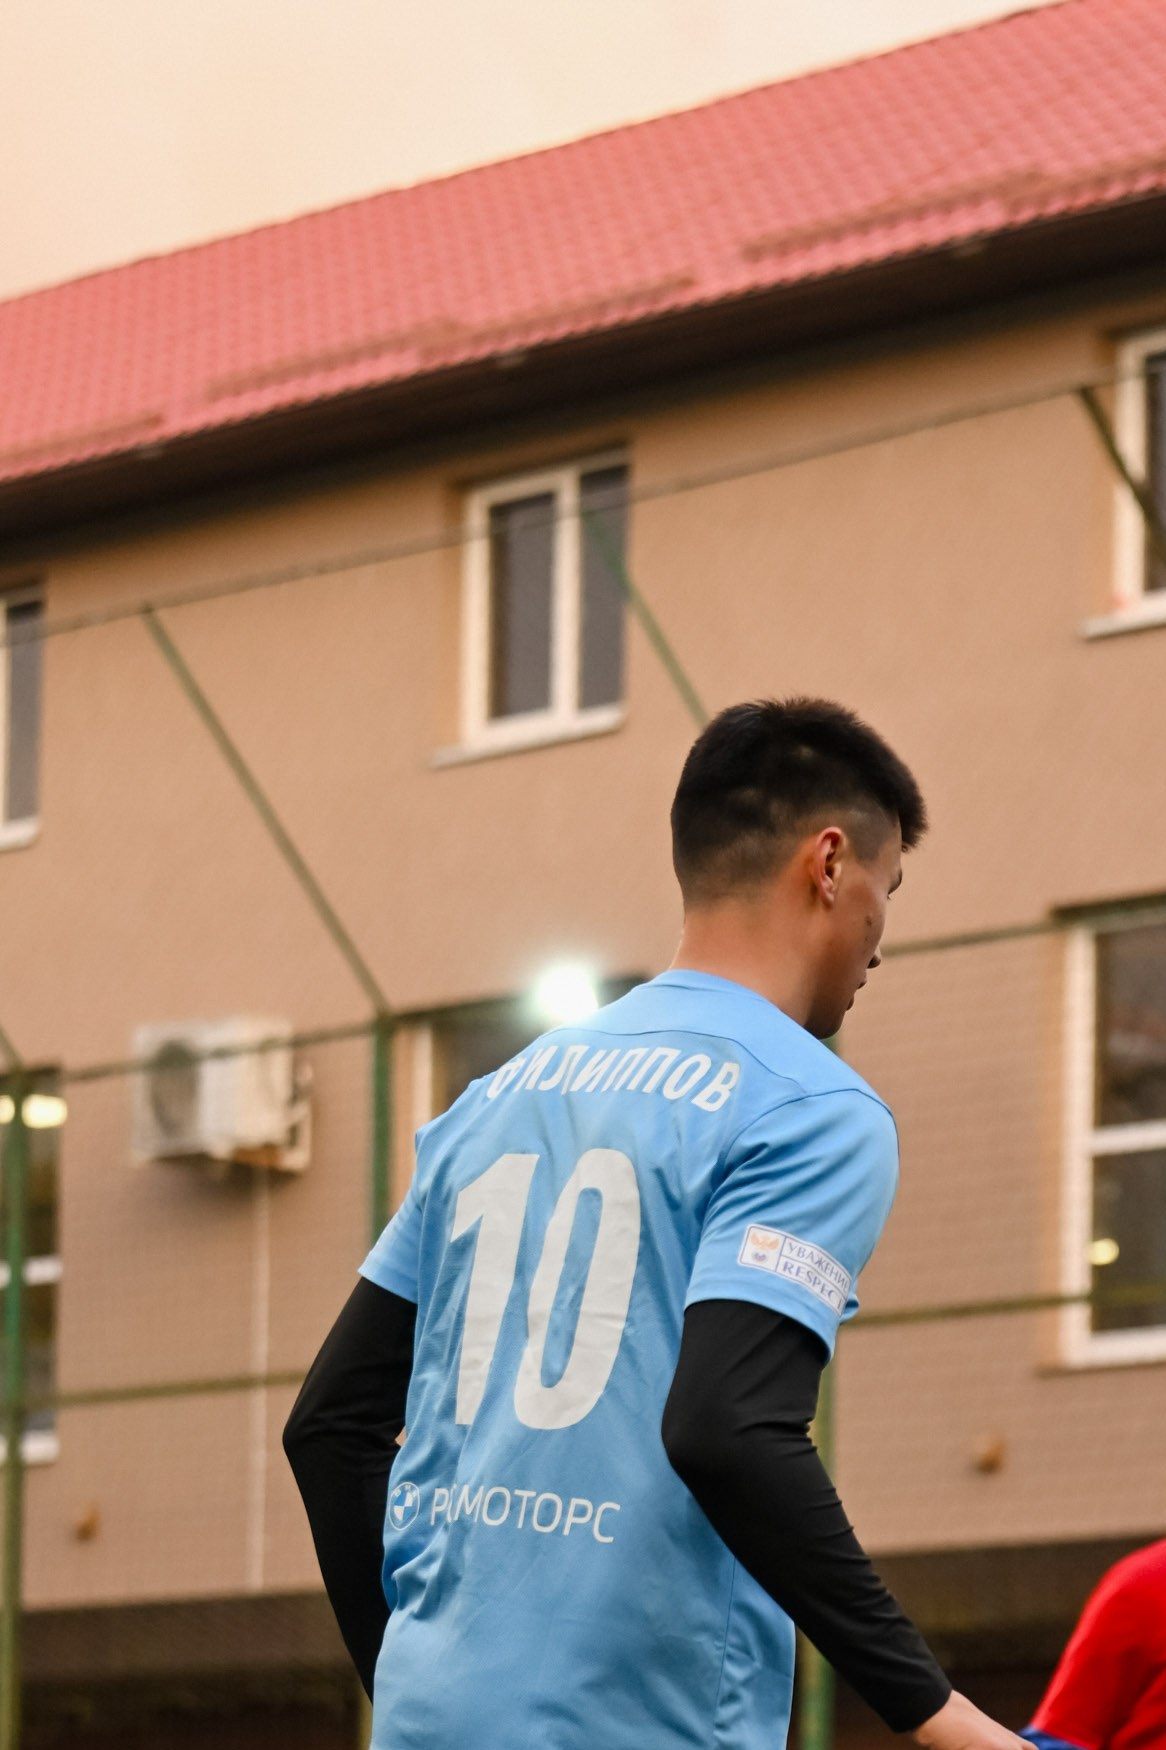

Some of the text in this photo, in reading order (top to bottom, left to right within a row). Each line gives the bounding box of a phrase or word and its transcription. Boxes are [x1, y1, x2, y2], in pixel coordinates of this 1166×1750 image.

[450, 1147, 641, 1430] 10
[787, 1242, 850, 1292] УВАЖЕНИЕ
[430, 1483, 621, 1544] РМОТОРС
